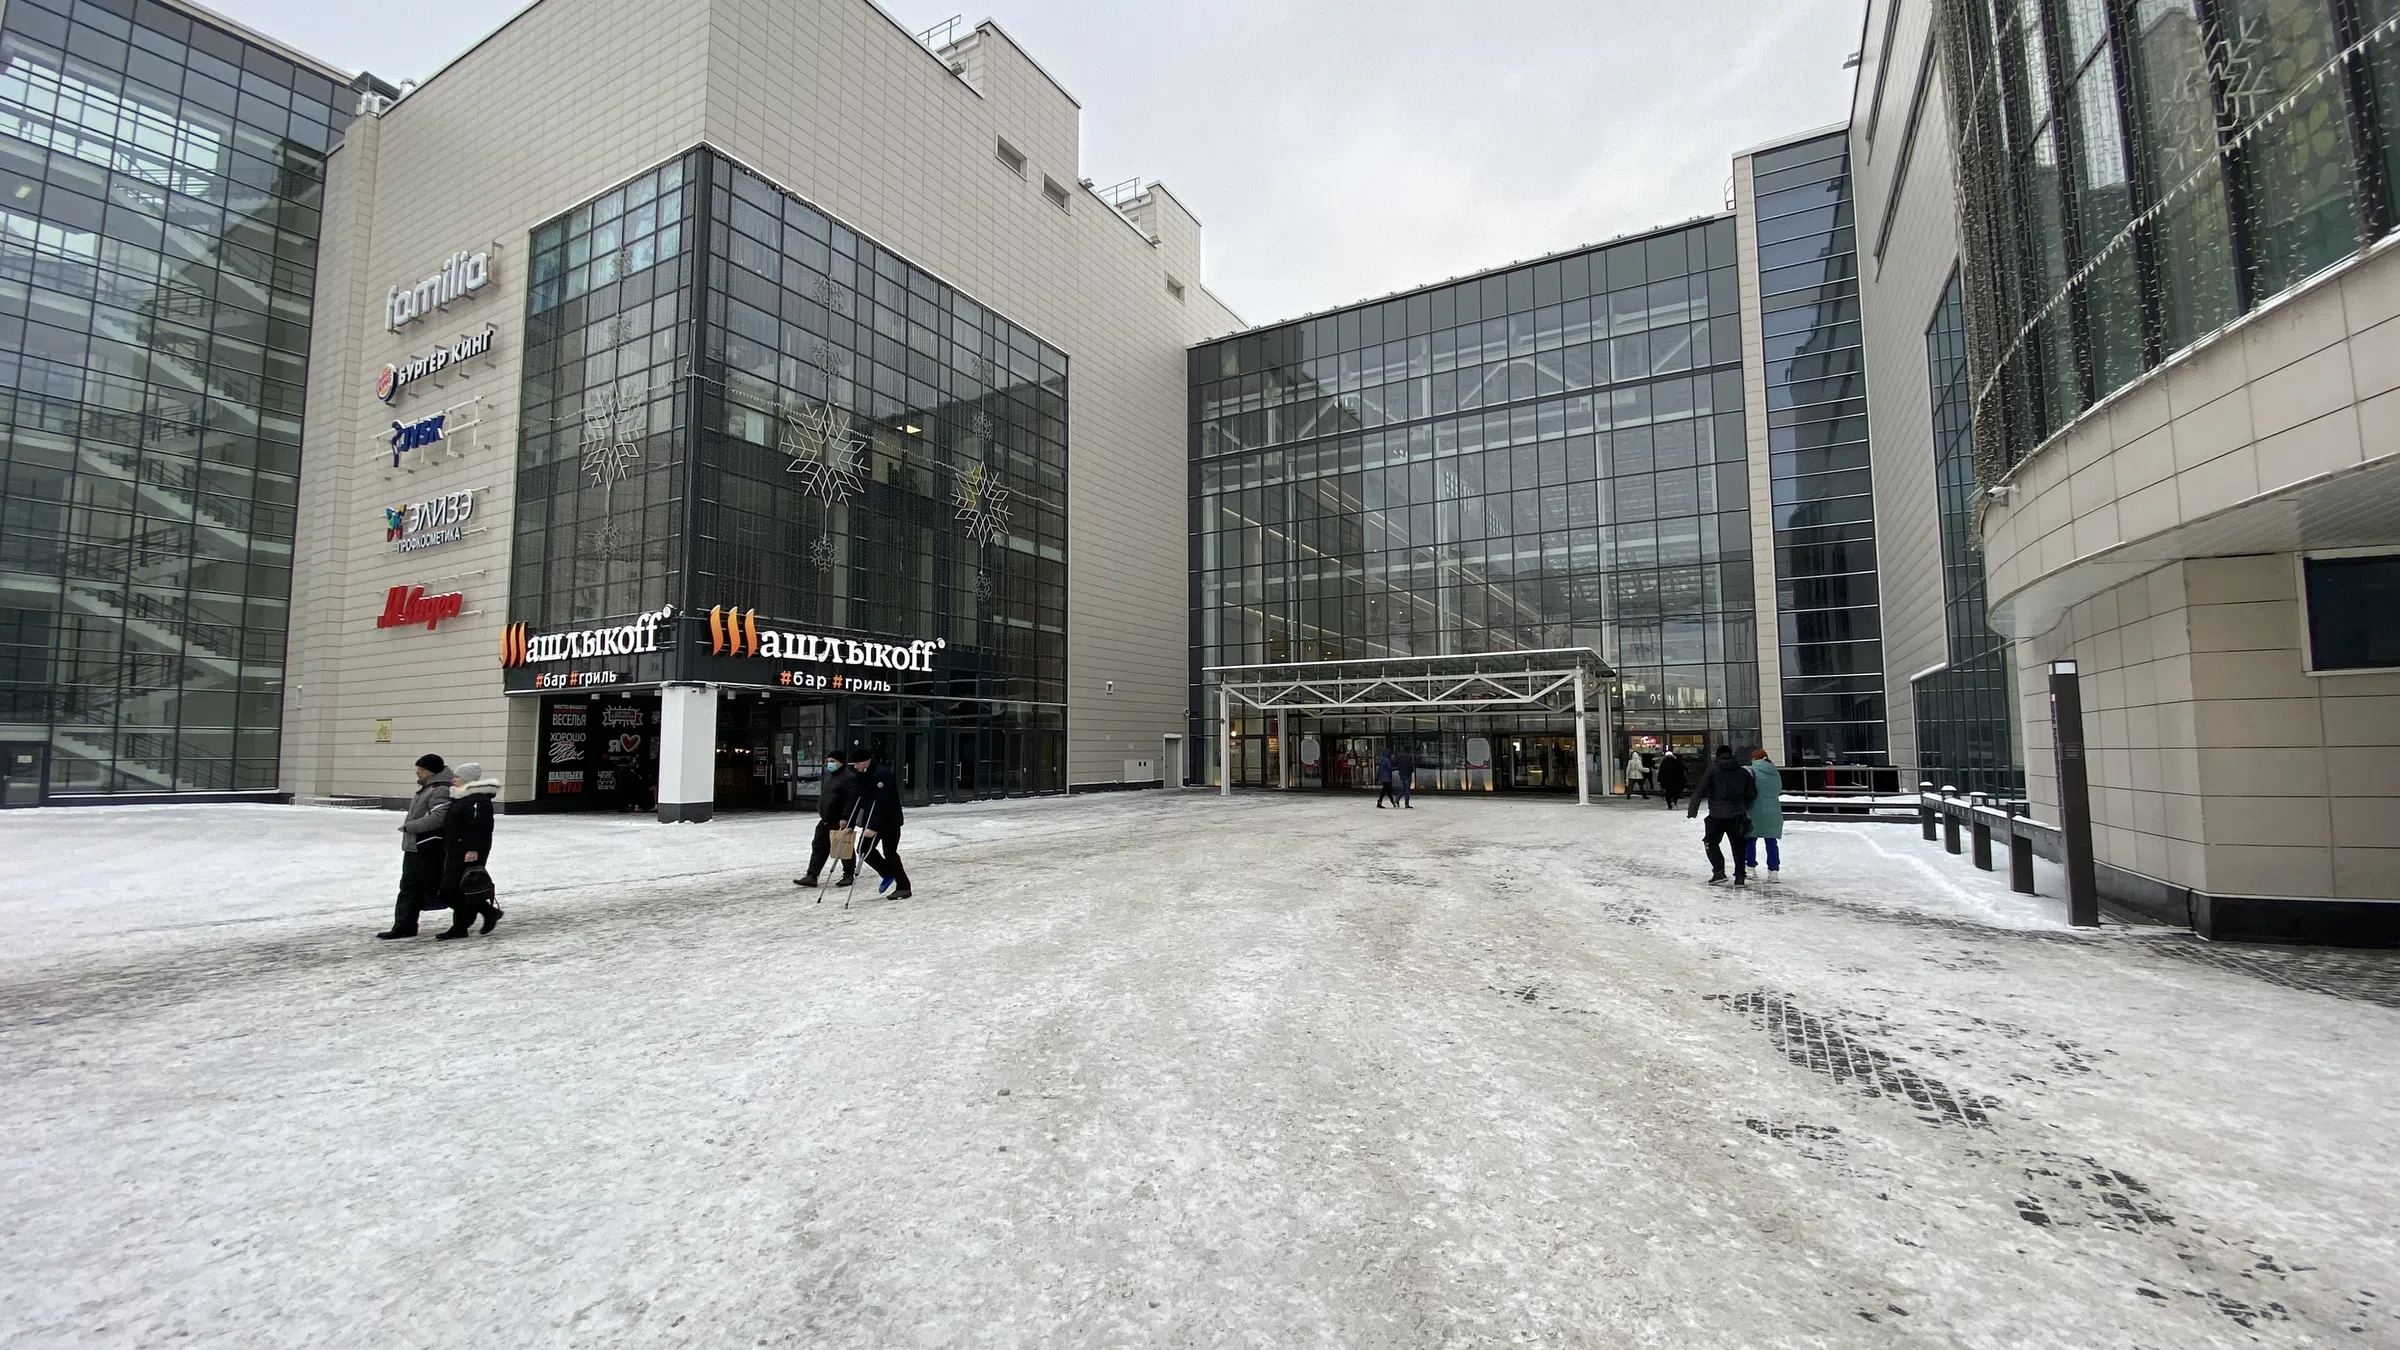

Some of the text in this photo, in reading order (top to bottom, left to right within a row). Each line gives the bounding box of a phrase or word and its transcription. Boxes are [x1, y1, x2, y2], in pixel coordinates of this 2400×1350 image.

[385, 250, 487, 330] familia
[399, 330, 494, 385] БУРГЕР КИНГ
[401, 415, 446, 452] JYSK
[408, 488, 474, 533] ЭЛИЗЭ
[398, 527, 463, 553] ПРОФКОСМЕТИКА
[535, 670, 618, 689] #бар #гриль
[780, 670, 892, 692] #бар #гриль
[552, 713, 587, 727] ВЕСЕЛЬЯ
[550, 732, 586, 742] ХОРОШО
[608, 739, 621, 753] Я
